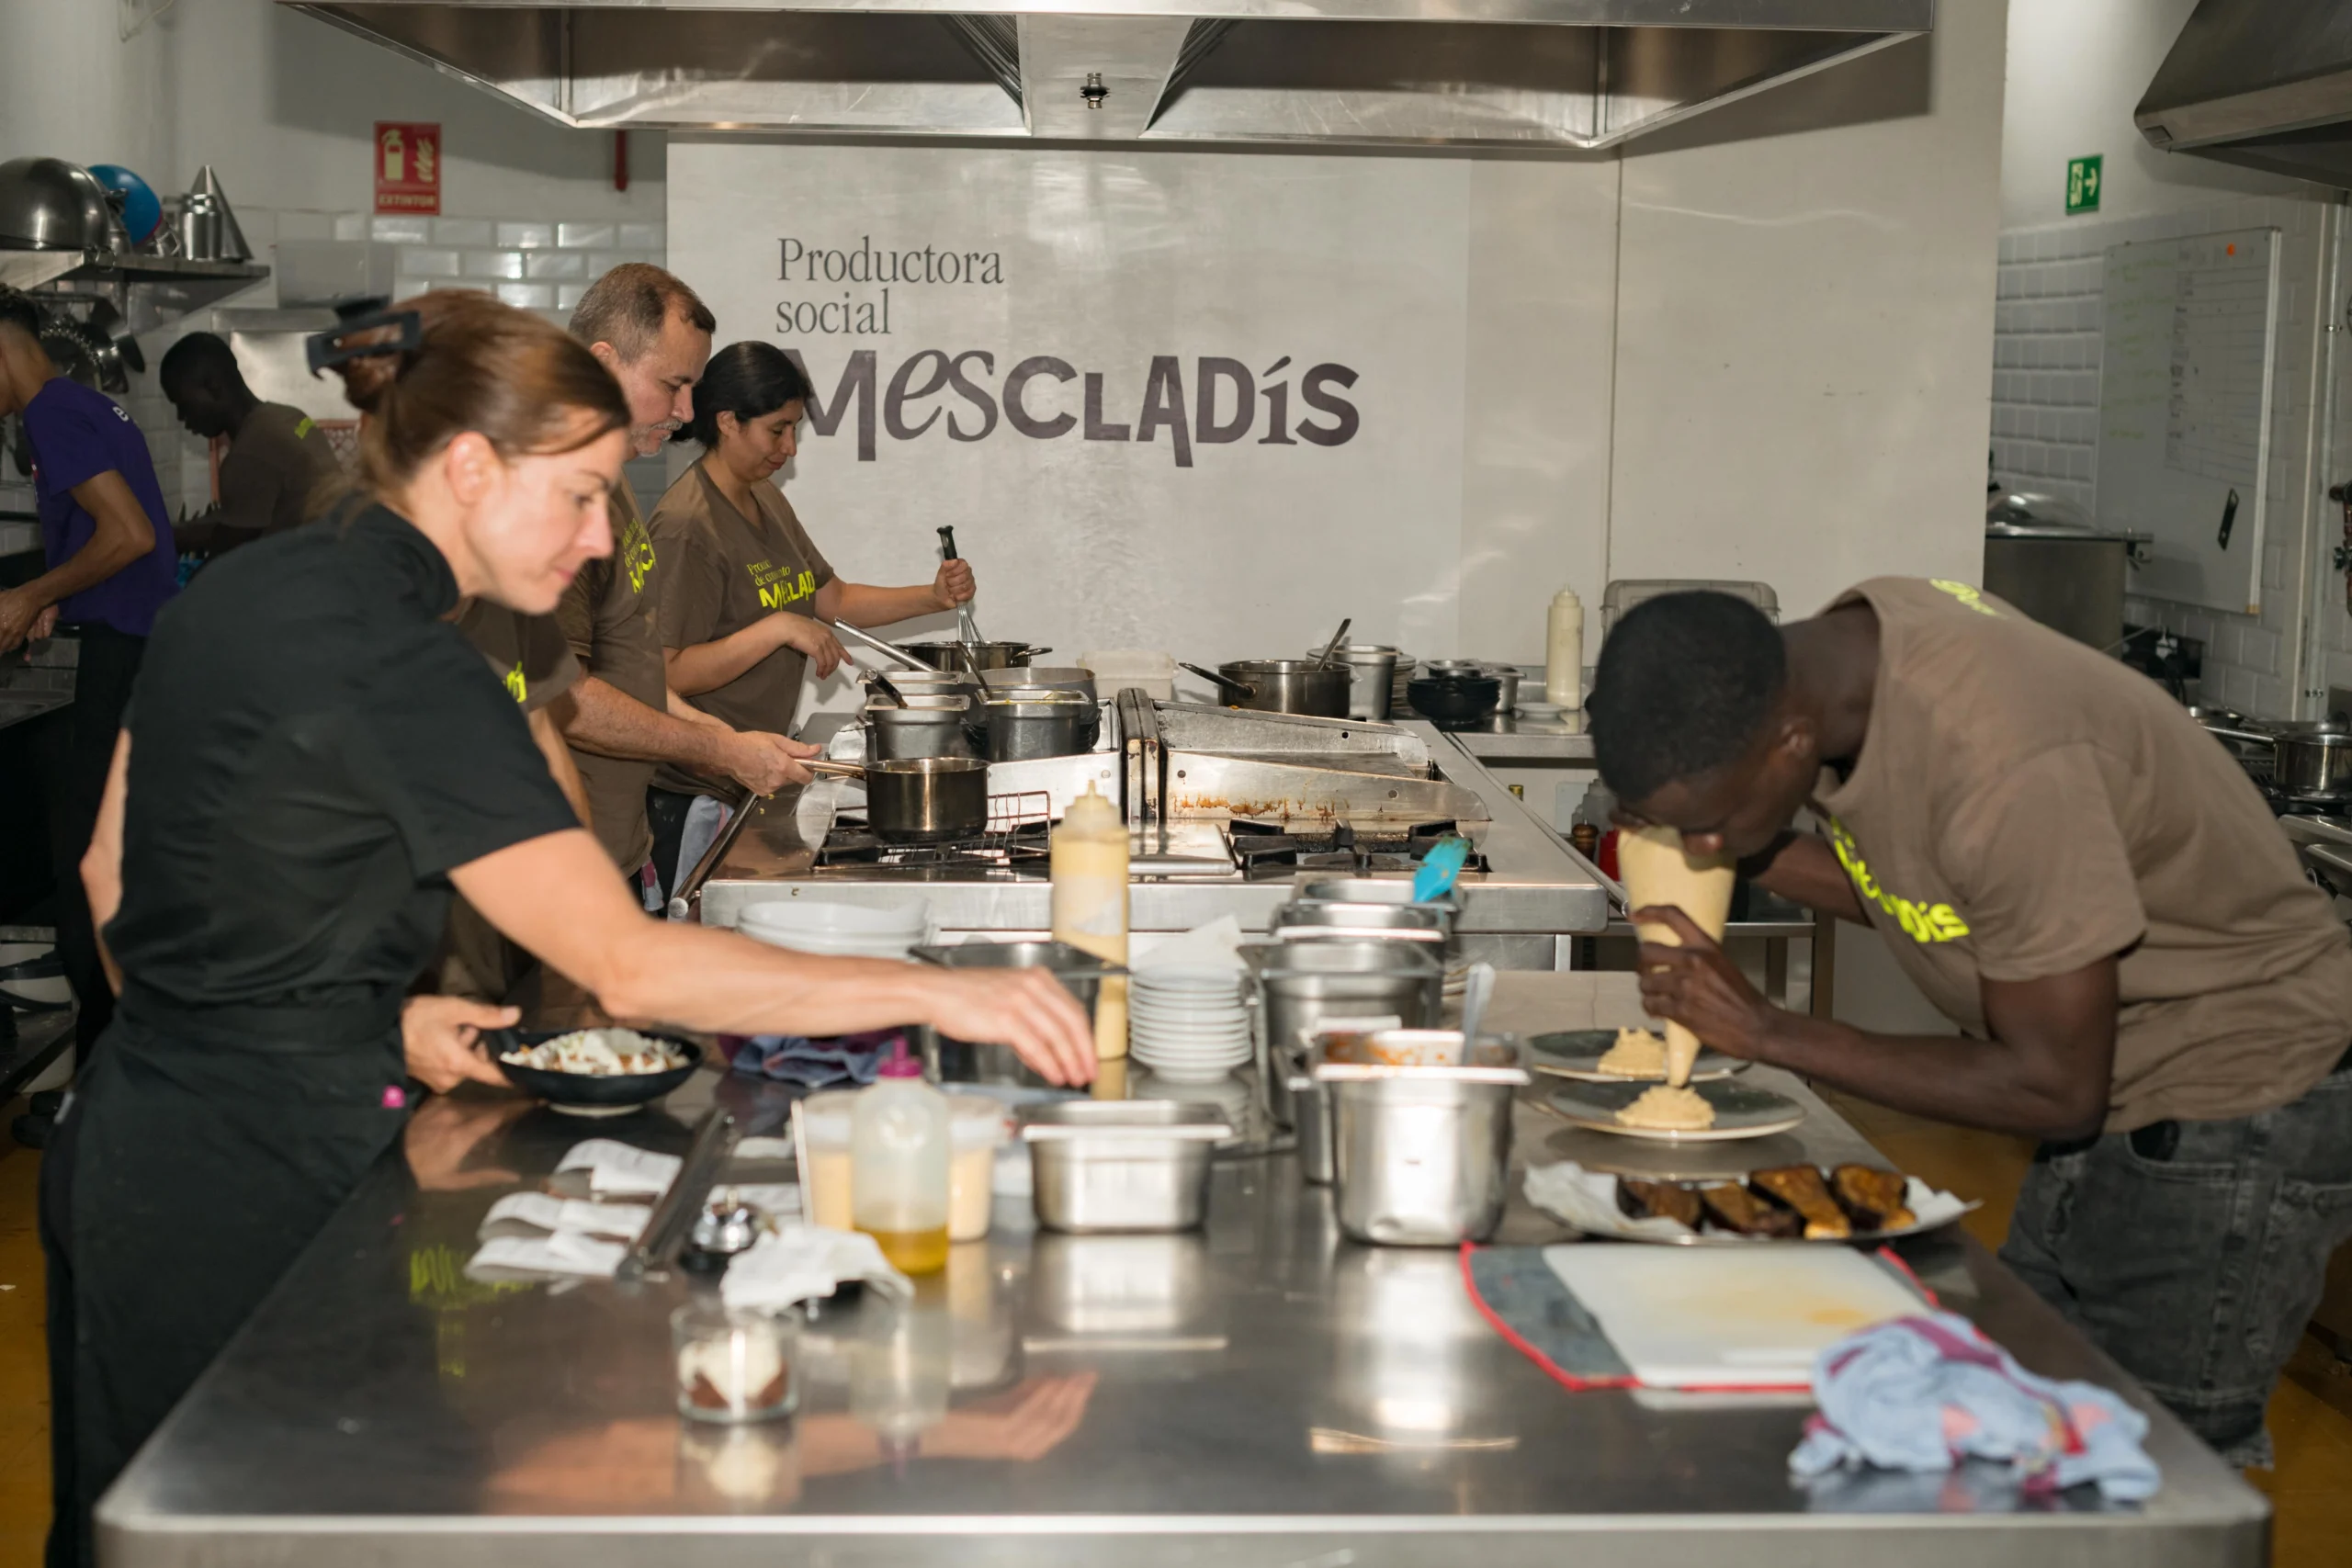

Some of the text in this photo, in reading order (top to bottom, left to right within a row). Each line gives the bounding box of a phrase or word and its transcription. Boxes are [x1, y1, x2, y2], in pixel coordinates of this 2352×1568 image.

[378, 194, 435, 208] EXTINTOR
[777, 235, 1004, 284] Productora
[776, 288, 890, 334] social
